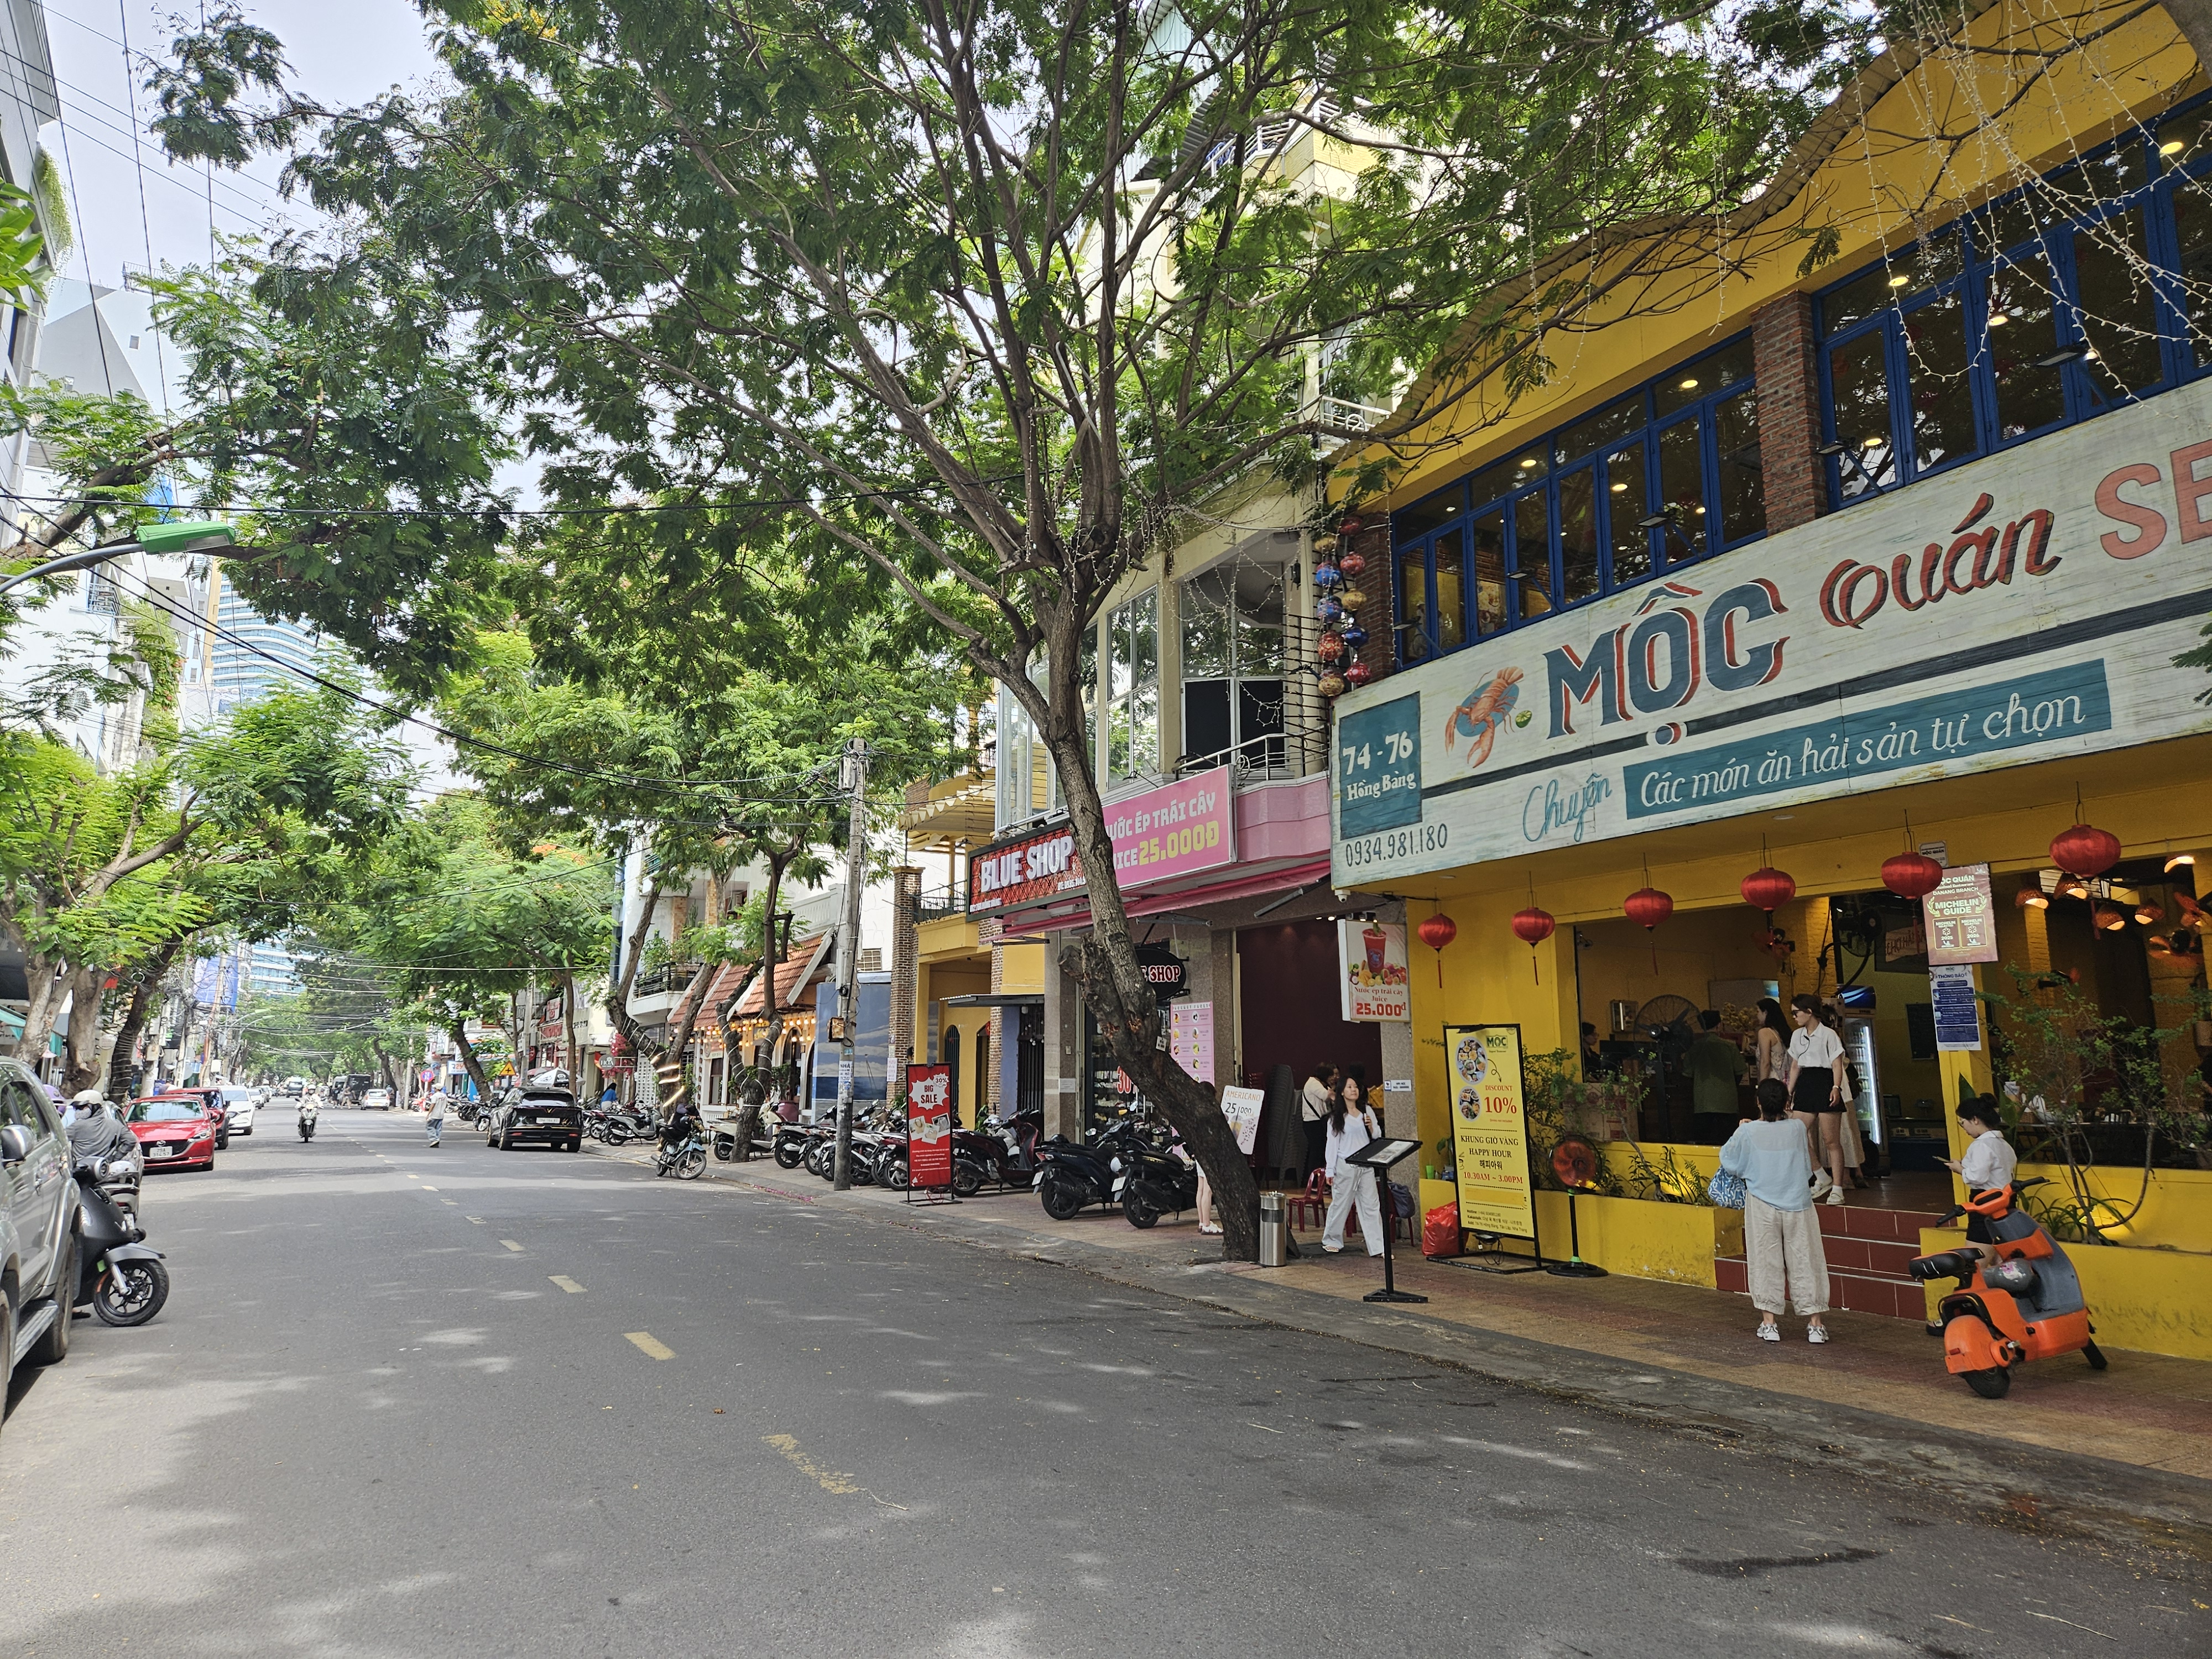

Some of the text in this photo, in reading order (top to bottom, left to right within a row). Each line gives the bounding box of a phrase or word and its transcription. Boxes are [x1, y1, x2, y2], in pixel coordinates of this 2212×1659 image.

[1542, 577, 1791, 745] MỘC
[1819, 492, 2063, 630] Quán
[1342, 742, 1371, 775] 74
[1385, 731, 1413, 764] 76
[1641, 692, 2086, 807] Các món ăn hải sản tự chọn
[1347, 770, 1417, 801] Hồng Bàng
[1135, 810, 1150, 834] ÉP
[1152, 799, 1186, 828] TRÁI
[1189, 790, 1215, 817] CÂY
[1522, 772, 1613, 842] Chuyên
[1139, 820, 1219, 866] 25.000Đ
[1345, 823, 1448, 867] 0934.981.180
[980, 835, 1076, 893] BLUE SHOP
[1952, 874, 1975, 883] QUÁN
[1934, 898, 1979, 909] MICHELIN
[1943, 906, 1972, 915] GUIDE
[1149, 965, 1181, 982] SHOP
[1357, 1002, 1406, 1016] 25.000đ
[924, 1084, 933, 1093] BIG
[1225, 1090, 1261, 1101] AMERICANO
[921, 1093, 937, 1104] SALE
[1484, 1097, 1517, 1114] 10%
[1460, 1135, 1519, 1146] KHUNG GIỜ VÀNG
[1492, 1150, 1512, 1158] HOUR
[1464, 1171, 1490, 1181] 10.30AM
[1498, 1175, 1523, 1184] 3.00PM
